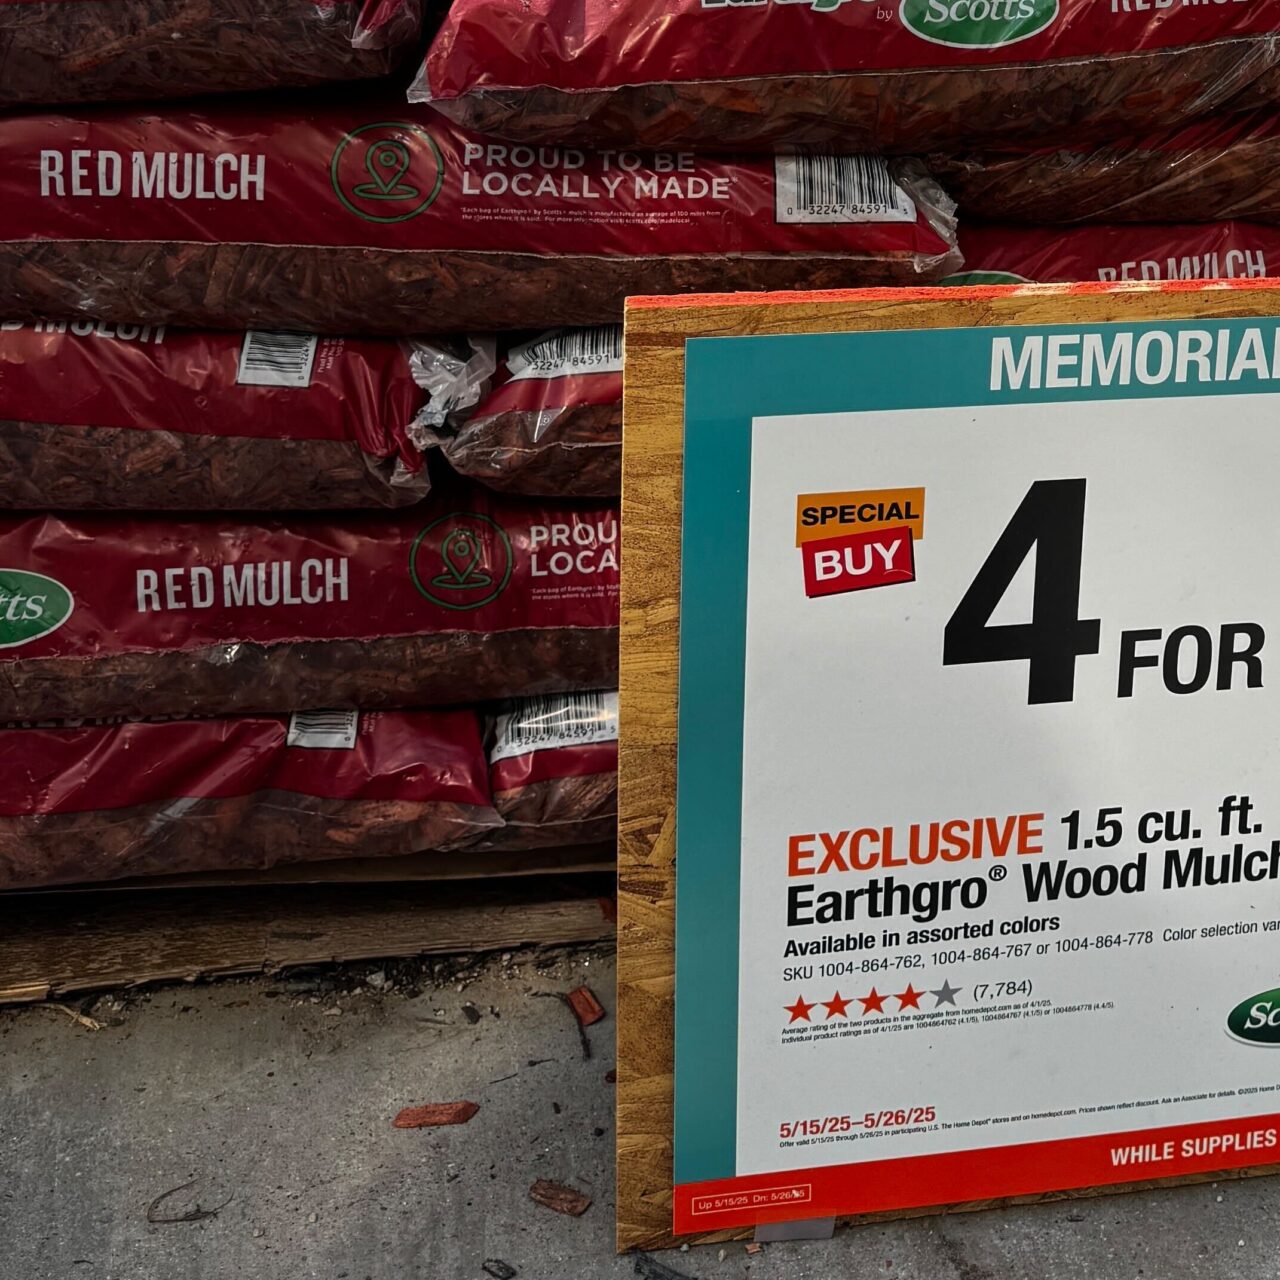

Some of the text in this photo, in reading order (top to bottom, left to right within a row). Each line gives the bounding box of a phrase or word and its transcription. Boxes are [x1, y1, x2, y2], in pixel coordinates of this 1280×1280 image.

[876, 6, 893, 21] by
[40, 149, 266, 202] RED MULCH
[464, 143, 697, 173] PROUD TO BE
[461, 171, 628, 199] LOCALLY
[808, 203, 889, 216] 32247 84591
[801, 501, 920, 526] SPECIAL
[814, 539, 903, 581] BUY
[136, 557, 349, 613] RED MULCH
[943, 478, 1101, 705] 4
[1117, 622, 1265, 698] FOR
[787, 795, 1263, 877] EXCLUSIVE 1.5 cu. ft.
[1022, 852, 1148, 903] Wood
[783, 915, 1061, 958] Available in assorted colors
[783, 965, 814, 982] SKU
[818, 954, 926, 978] 1004-864-762,
[931, 943, 1032, 966] 1004-864-767
[1036, 942, 1051, 955] or
[1055, 931, 1154, 954] 1004-864-778
[1163, 926, 1198, 942] Color
[1200, 920, 1259, 939] selection
[973, 979, 1033, 1003] (7,784)
[1110, 1142, 1175, 1166] WHILE
[1181, 1128, 1277, 1158] SUPPLIES
[698, 1202, 713, 1210] Up
